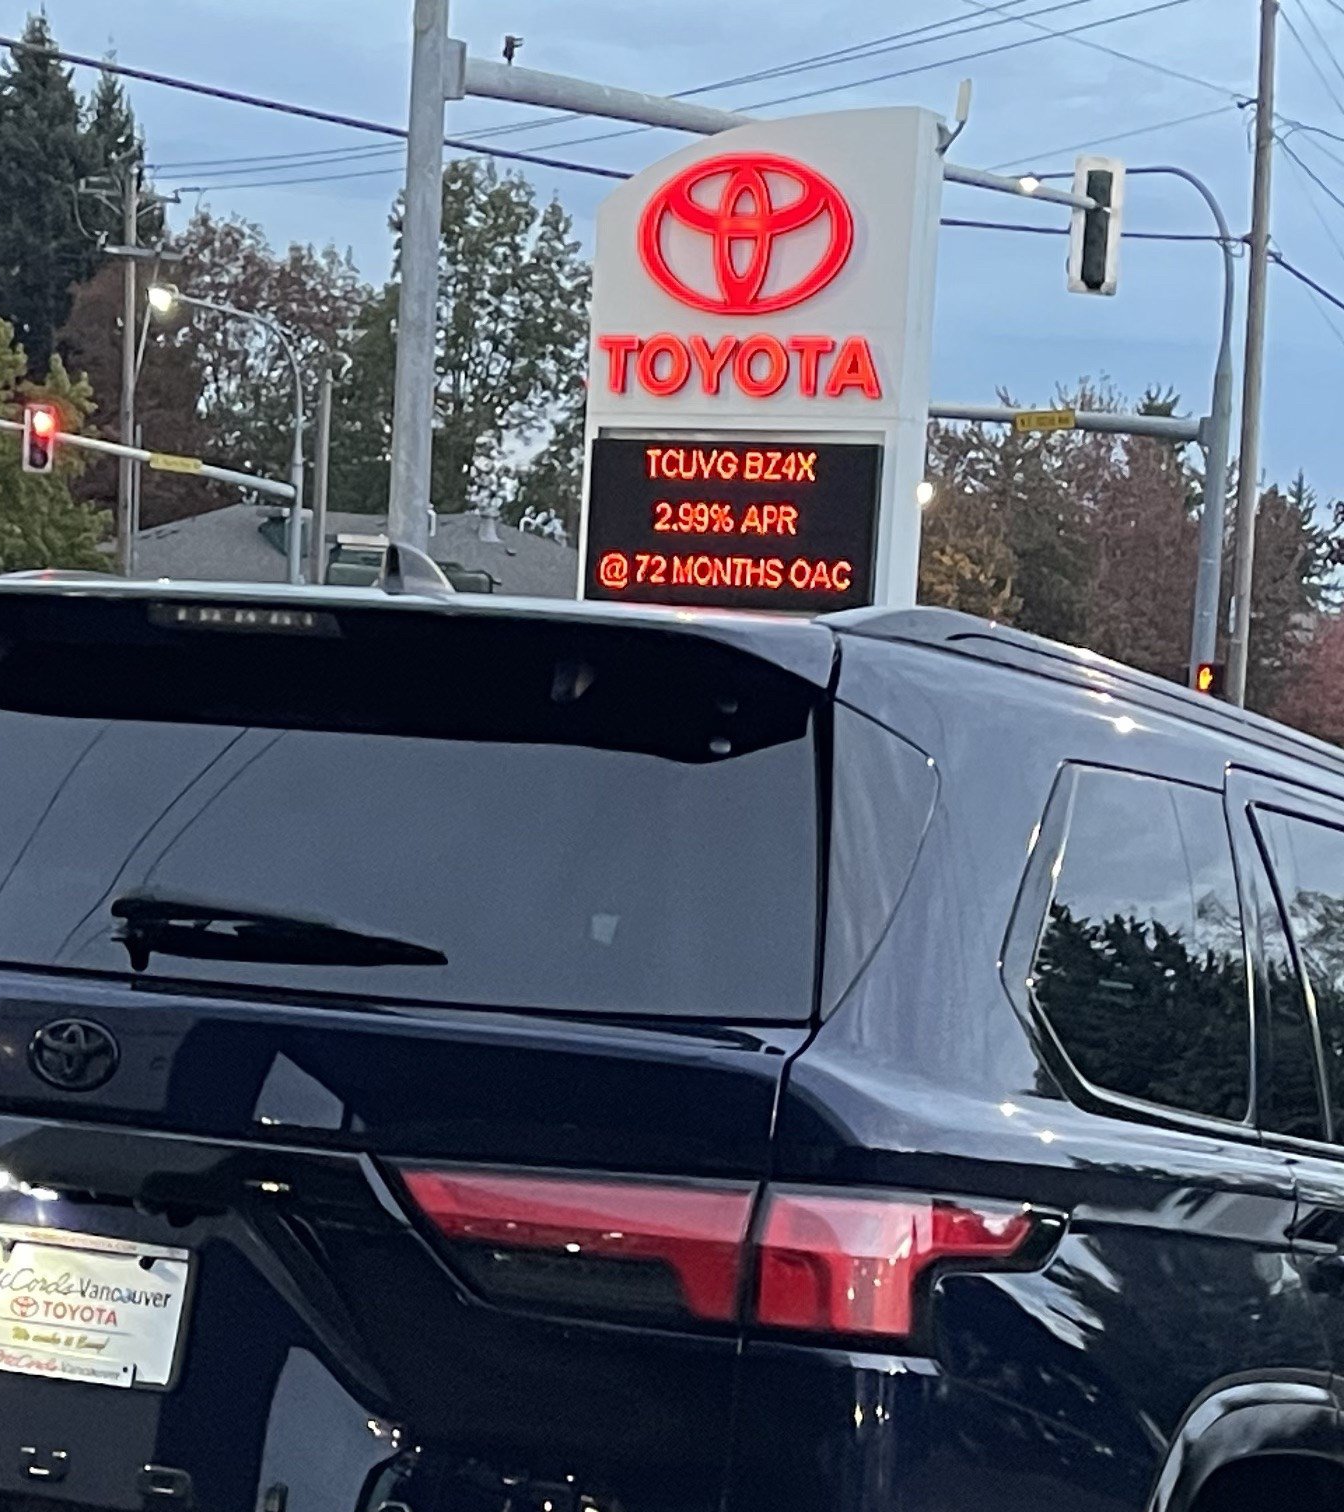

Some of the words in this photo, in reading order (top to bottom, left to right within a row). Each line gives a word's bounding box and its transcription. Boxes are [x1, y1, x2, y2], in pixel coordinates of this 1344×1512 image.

[598, 334, 883, 399] TOYOTA
[645, 448, 738, 480] TCUVG
[743, 450, 817, 481] BZ4X
[653, 502, 735, 533] 2.99%
[740, 504, 799, 535] APR
[599, 551, 629, 588] @
[634, 553, 666, 583] 72
[671, 553, 784, 588] MONTHS
[789, 558, 852, 590] OAC
[79, 1278, 172, 1308] Vancouver
[42, 1300, 118, 1327] TOYOTA
